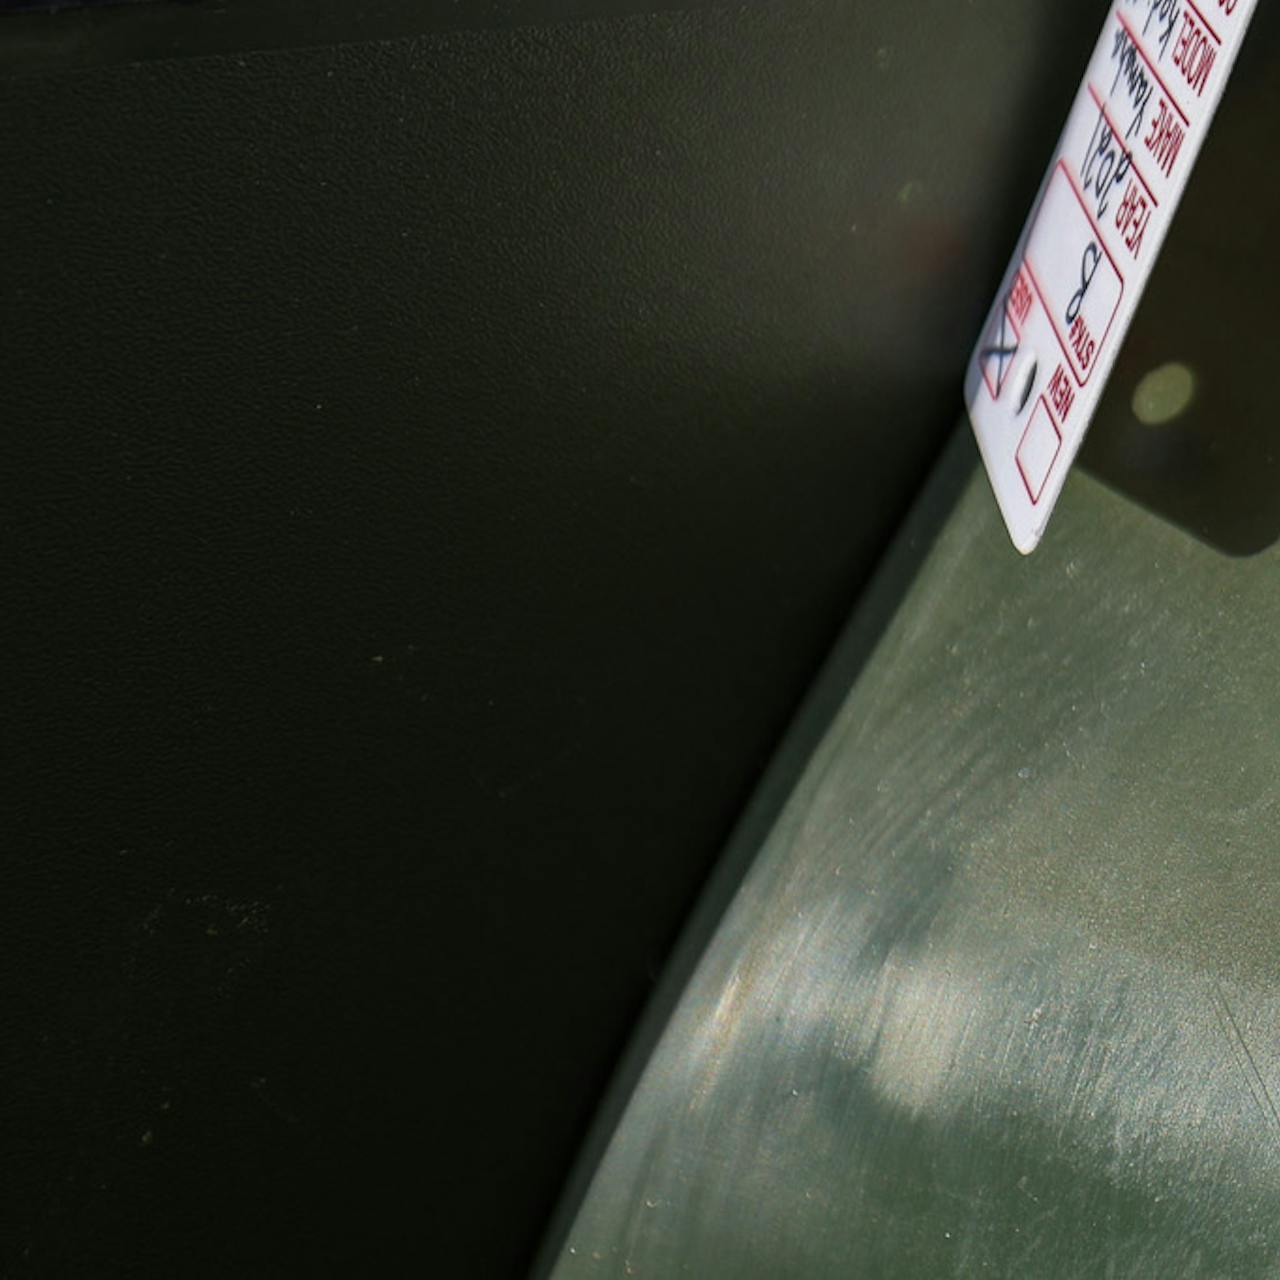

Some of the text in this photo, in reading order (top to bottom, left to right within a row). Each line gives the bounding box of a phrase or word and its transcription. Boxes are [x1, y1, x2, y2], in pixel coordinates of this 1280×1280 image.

[1172, 10, 1216, 96] MODEL
[1111, 30, 1184, 176] MAKE Yamaha
[1080, 104, 1151, 256] YEAR 2021
[1009, 268, 1036, 331] USED
[1048, 364, 1076, 423] NEW
